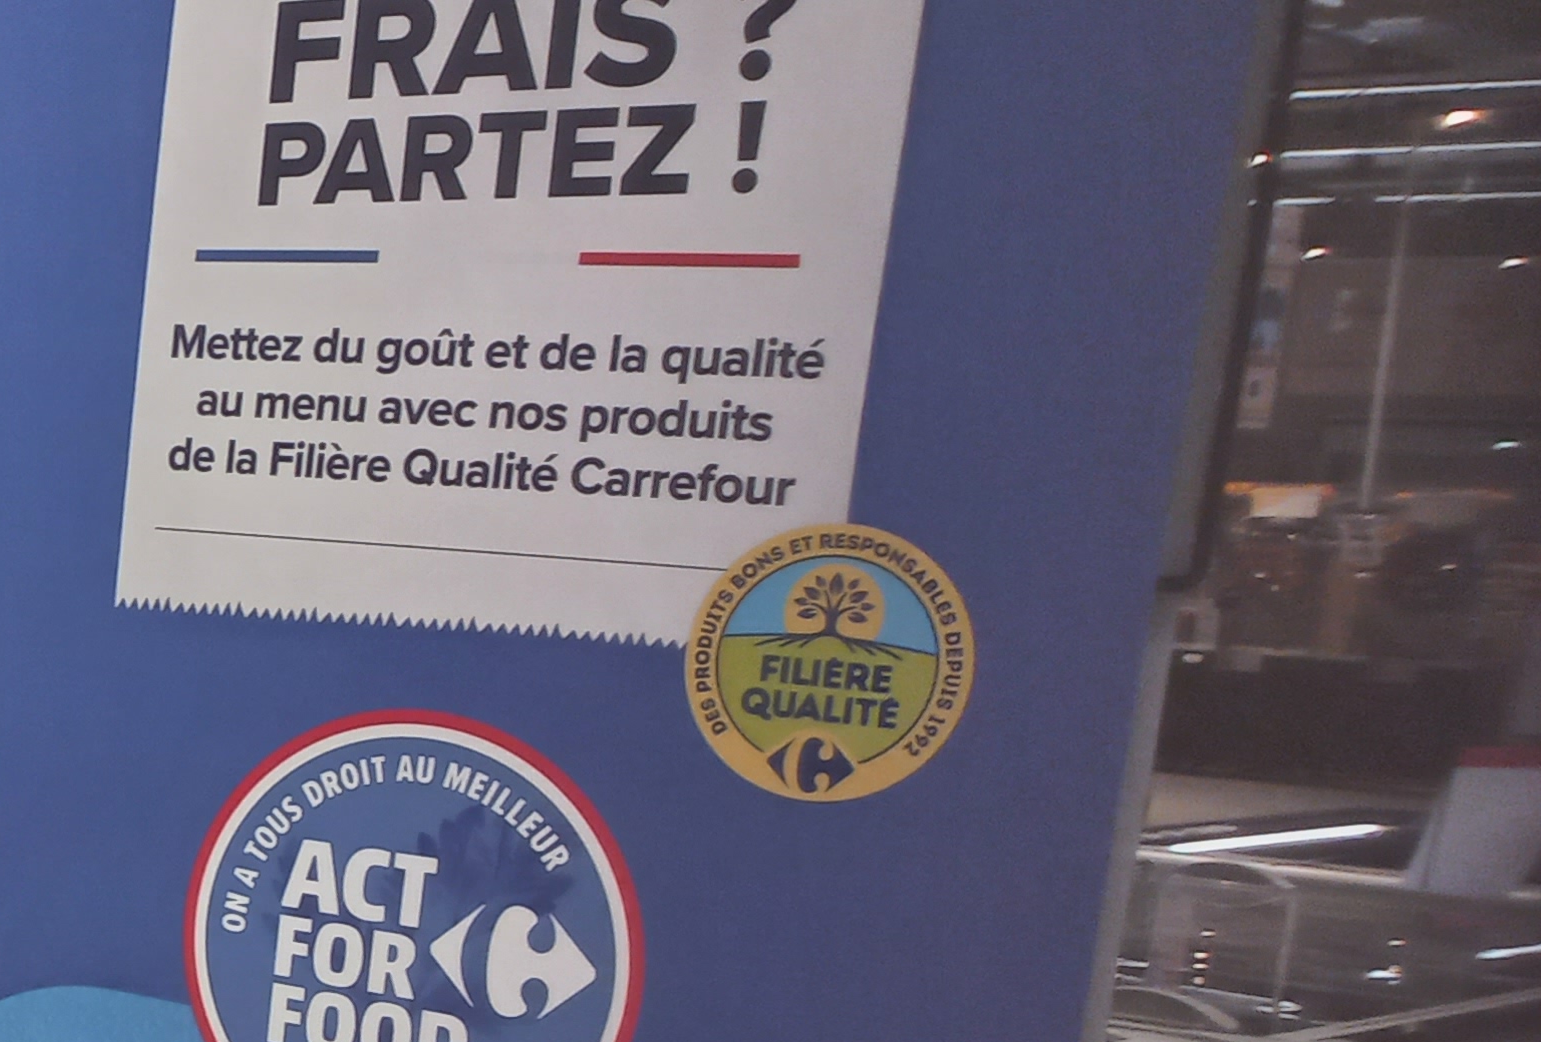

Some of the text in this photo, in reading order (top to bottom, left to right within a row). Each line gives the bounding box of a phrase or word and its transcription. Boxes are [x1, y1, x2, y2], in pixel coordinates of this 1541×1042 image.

[269, 0, 678, 103] FRAIS
[258, 100, 768, 207] PARTEZ !
[170, 324, 827, 386] Mettez du goût et de la qualité
[196, 388, 773, 443] au menu avec nos produits
[167, 437, 797, 508] de la Filière Qualité Carrefour
[694, 532, 965, 759] DES PRODUITS BONS ET RESPONSABLES DEPUIS 1992
[759, 654, 894, 695] FILIÈRE
[740, 686, 902, 731] QUALITÉ
[221, 754, 573, 935] ON A TOUS DROIT AU MEILLEUR
[280, 838, 440, 930] ACT
[272, 912, 418, 1001] FOR
